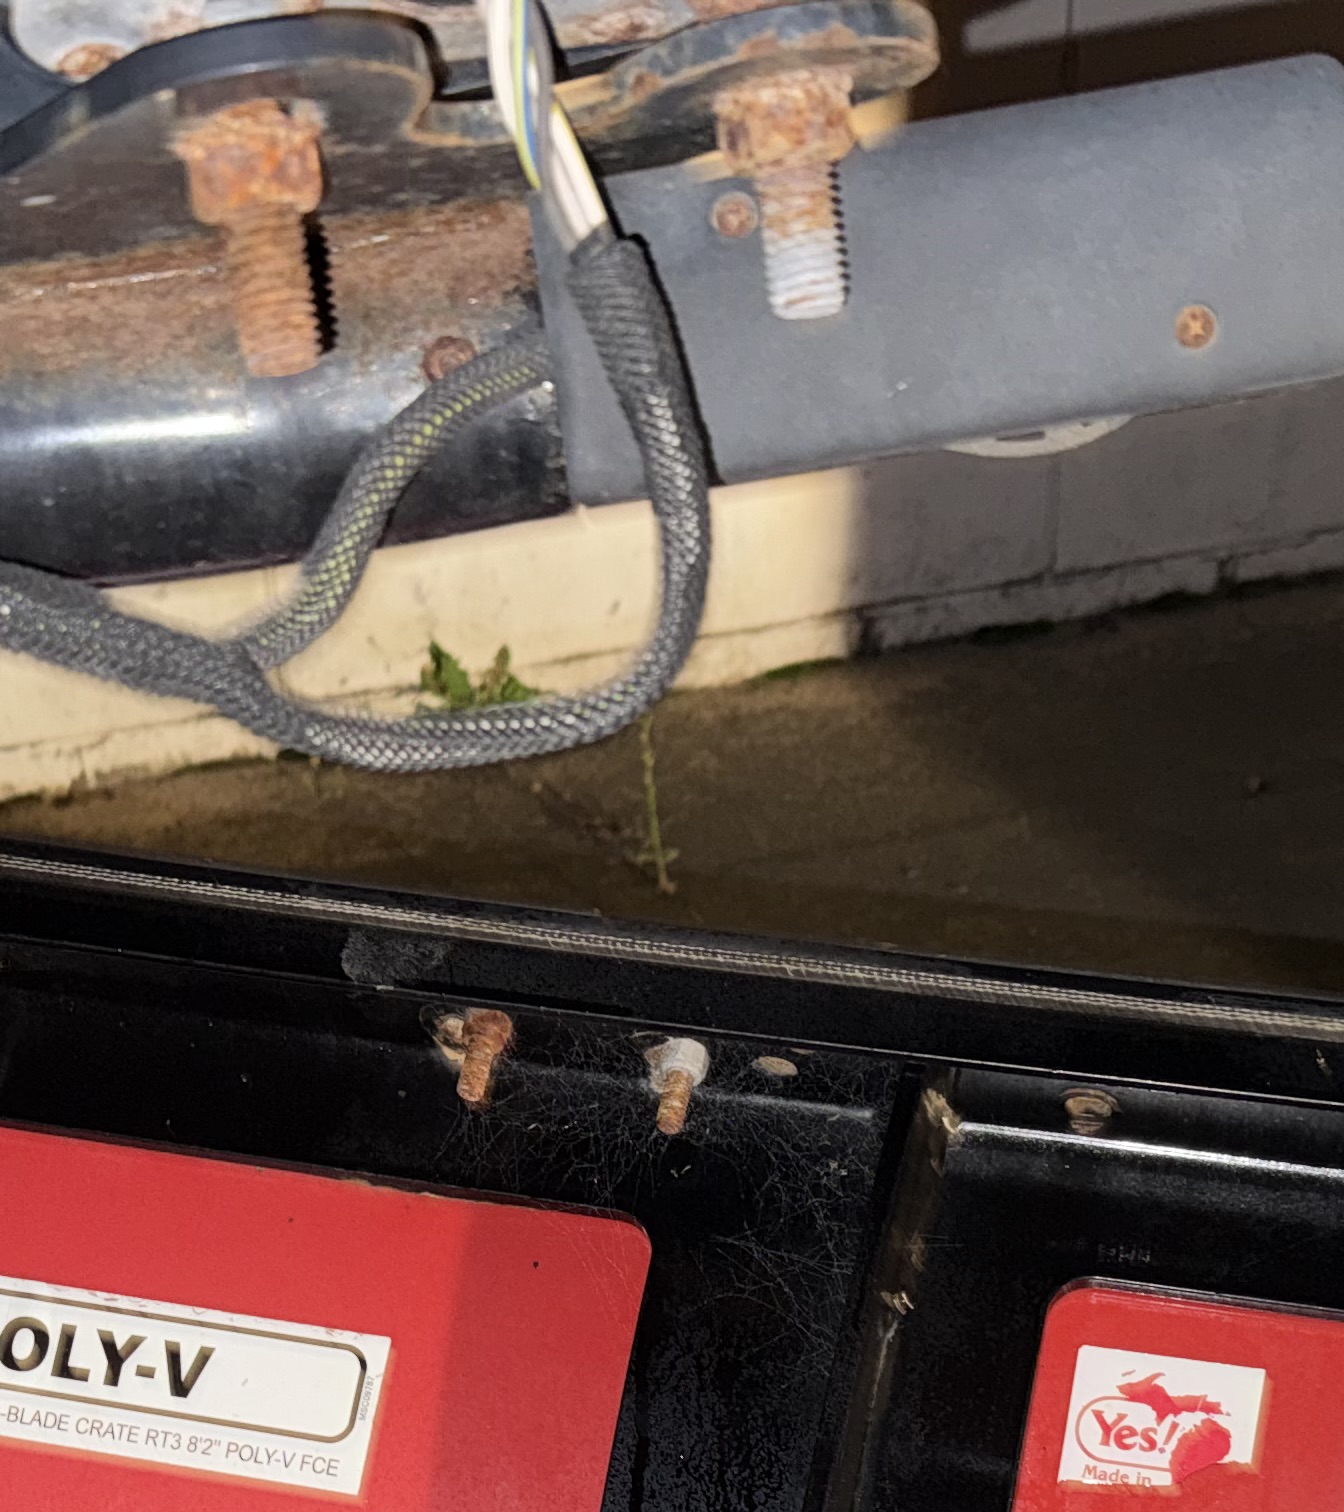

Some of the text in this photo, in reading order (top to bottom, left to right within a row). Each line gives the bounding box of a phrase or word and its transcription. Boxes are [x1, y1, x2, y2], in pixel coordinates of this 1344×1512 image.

[75, 1417, 141, 1444] CRATE
[144, 1428, 182, 1450] RT3
[186, 1435, 222, 1456] 8'2"
[225, 1441, 297, 1469] POLY-V
[299, 1455, 341, 1478] FCE
[1090, 1407, 1181, 1455] Yes!
[1081, 1463, 1152, 1486] Made in
